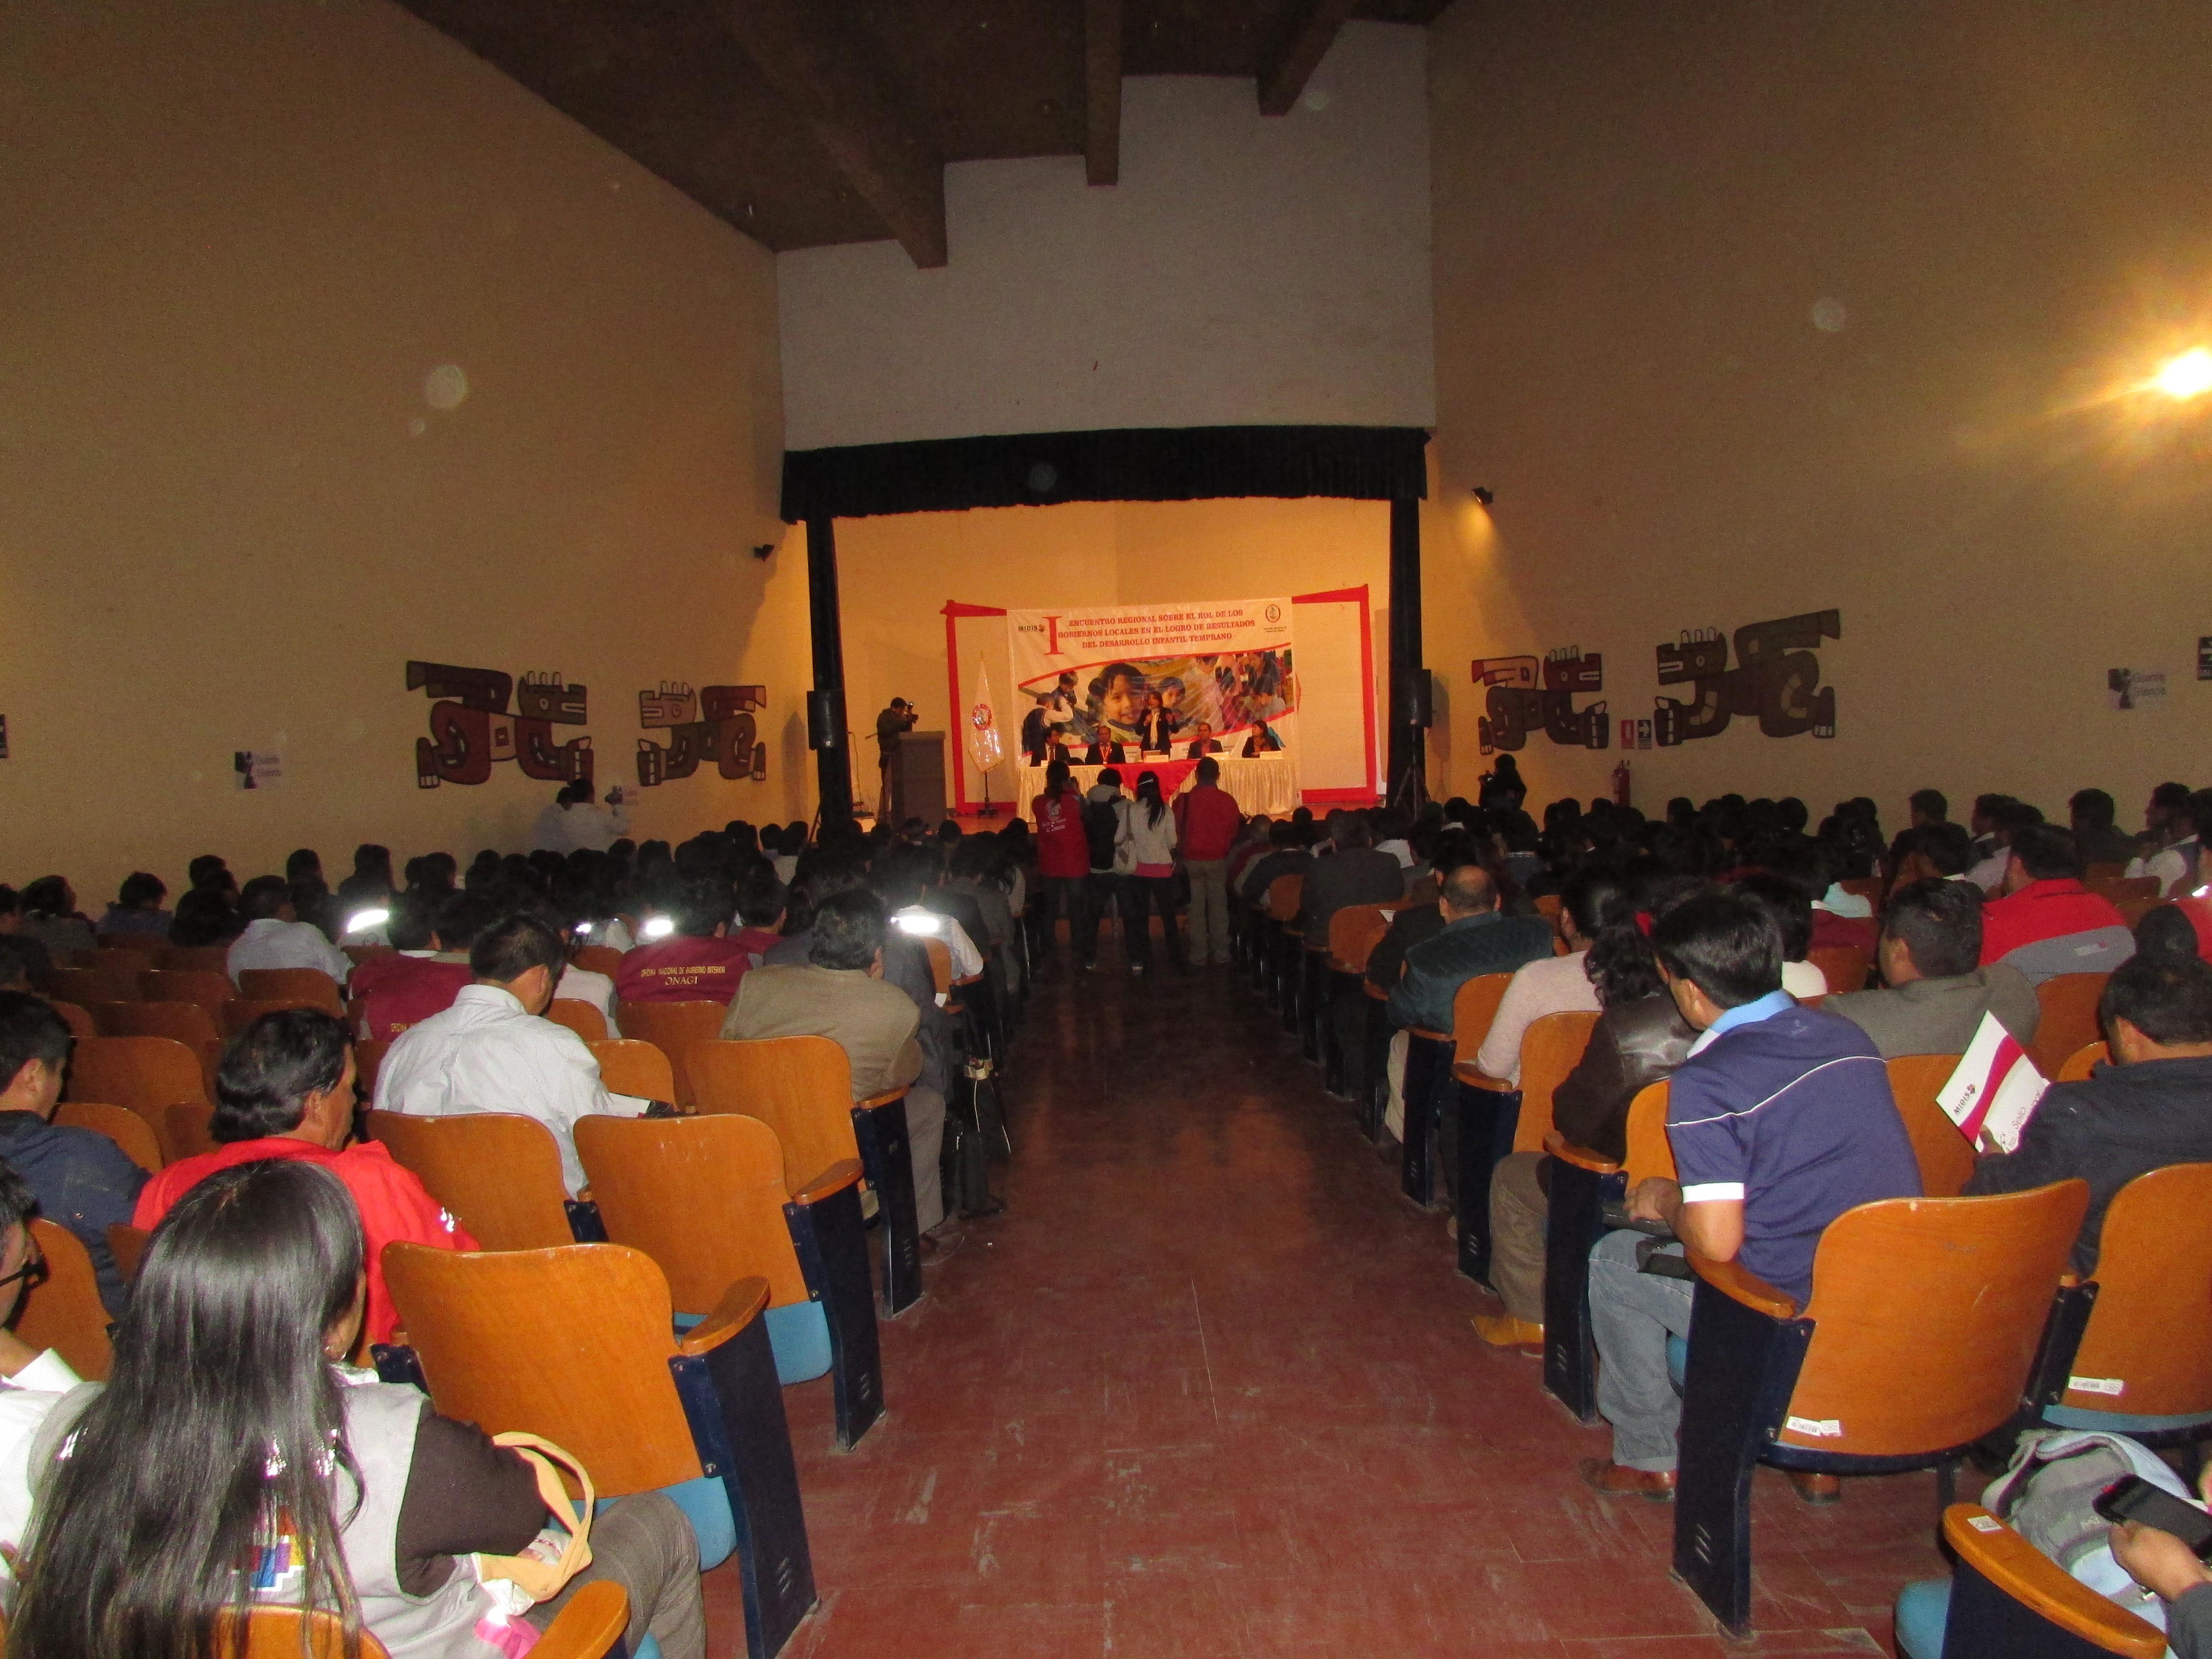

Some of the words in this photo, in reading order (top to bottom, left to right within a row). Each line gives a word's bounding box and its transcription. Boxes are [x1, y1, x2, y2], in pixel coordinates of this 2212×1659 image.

[1058, 630, 1103, 638] GOBIERNOS
[1105, 628, 1139, 636] LOCALES
[1165, 624, 1191, 633] LOGRO
[1206, 620, 1255, 630] RESULTADOS
[1069, 618, 1115, 627] ENCUENTRO
[1118, 615, 1156, 624] REGIONAL
[1158, 613, 1184, 622] SOBRE
[1042, 616, 1064, 655] I
[1099, 637, 1150, 647] DESARROLLO
[1153, 636, 1188, 644] INFANTIL
[1189, 633, 1232, 642] TEMPRANO
[1953, 1092, 1970, 1114] MIDIS
[2012, 1107, 2026, 1129] Sello
